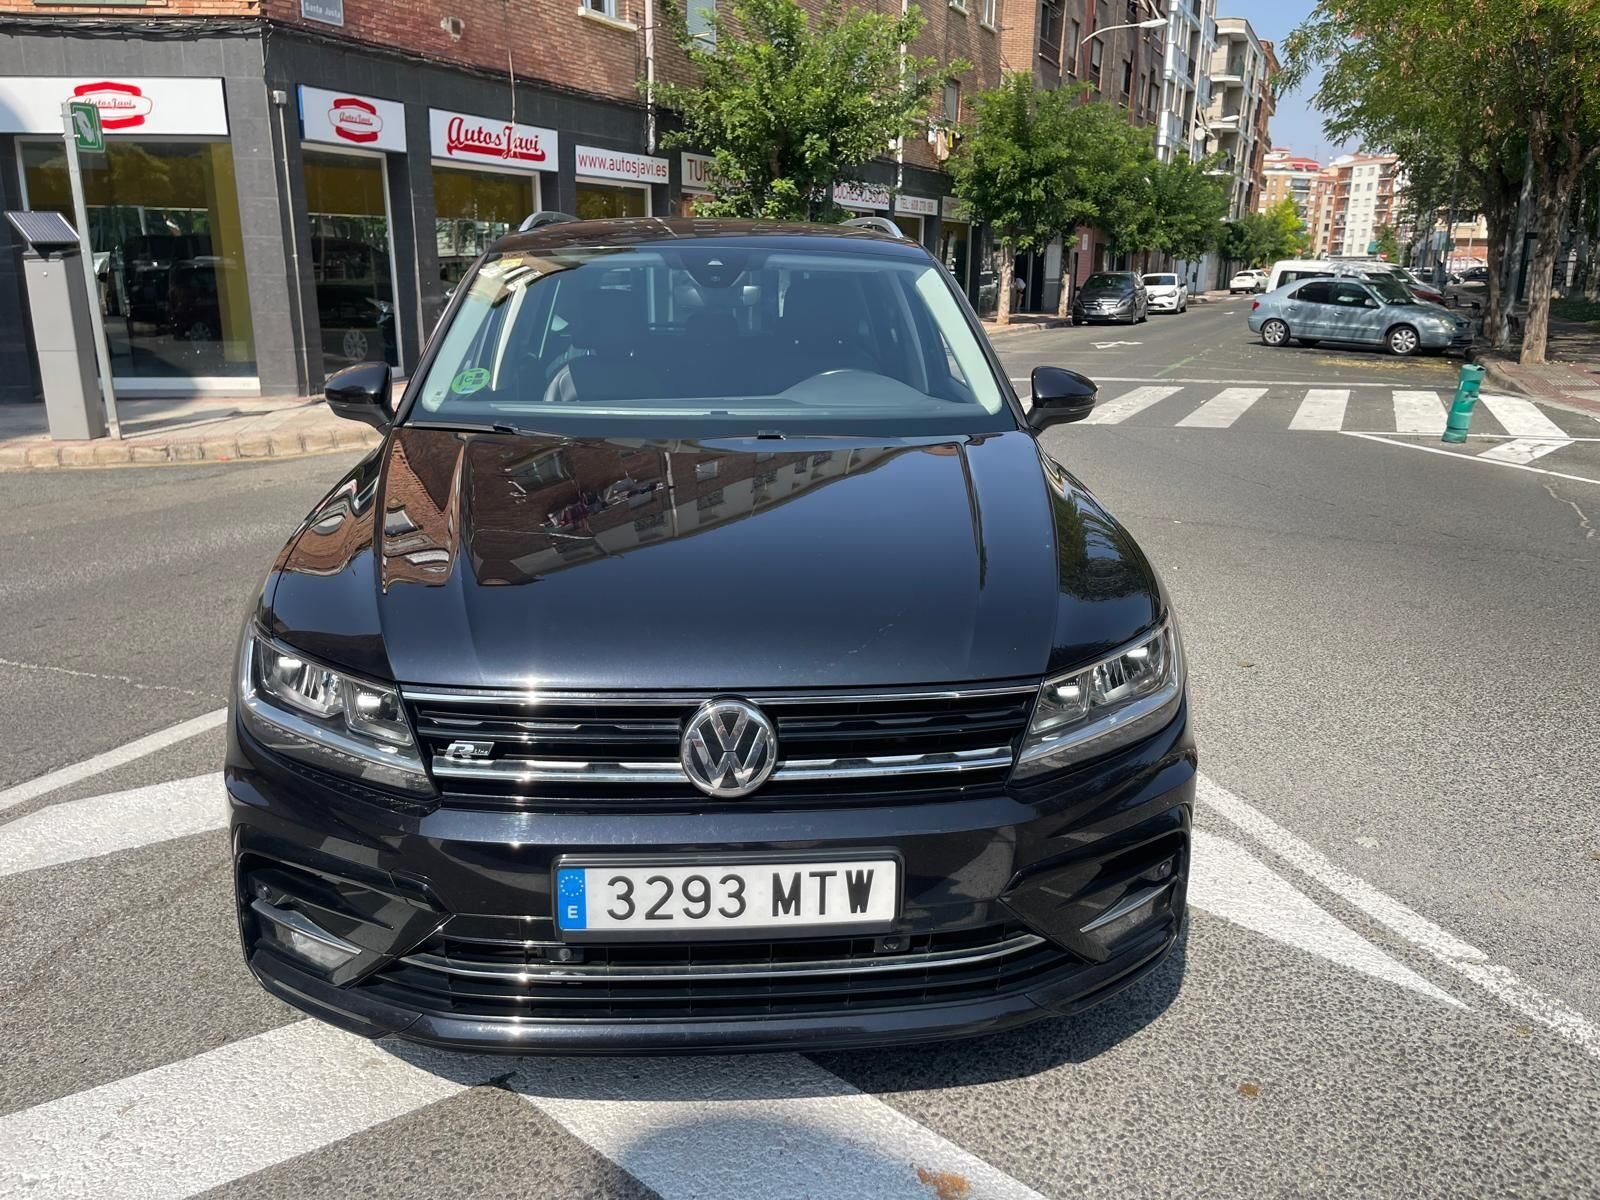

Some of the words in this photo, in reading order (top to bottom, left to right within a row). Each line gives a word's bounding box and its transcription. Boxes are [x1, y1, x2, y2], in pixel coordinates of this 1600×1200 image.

[578, 154, 667, 178] www.autosjavi.es
[606, 873, 747, 921] 3293
[771, 869, 875, 917] MTW
[567, 905, 579, 919] E
